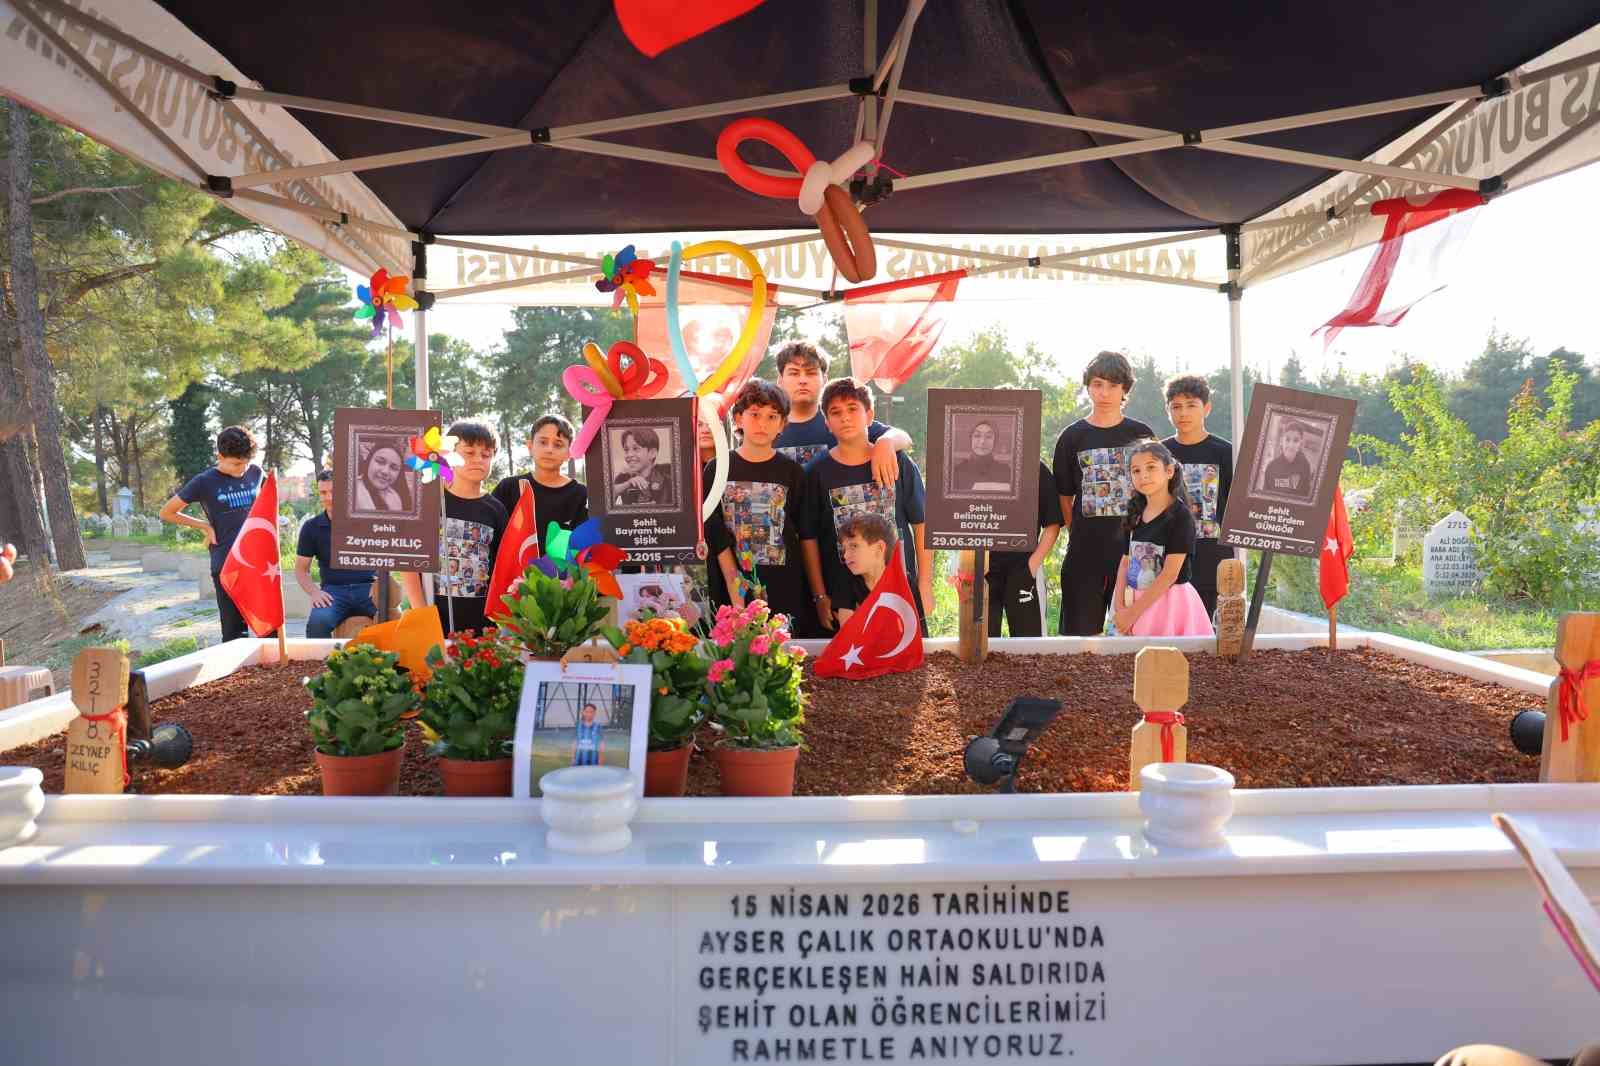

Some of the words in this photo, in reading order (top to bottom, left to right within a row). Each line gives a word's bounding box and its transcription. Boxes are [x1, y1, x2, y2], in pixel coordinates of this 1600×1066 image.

[633, 518, 657, 527] Şehit
[953, 512, 988, 521] Belinay
[990, 512, 1007, 520] Nur
[1248, 510, 1276, 522] Kerem
[1277, 515, 1305, 527] Erdem
[372, 524, 396, 533] Şehit
[615, 527, 652, 536] Bayram
[654, 526, 675, 534] Nabi
[960, 521, 1000, 530] BOYRAZ
[1255, 521, 1294, 534] GÜNGÖR
[1447, 521, 1468, 529] 2715
[346, 536, 389, 549] Zeynep
[391, 538, 422, 549] KILIÇ
[932, 536, 994, 547] 29.06.2015
[1227, 534, 1282, 550] 28.07.2015
[338, 556, 395, 567] 18.05.2015
[70, 743, 112, 759] ZEYNEP
[730, 893, 758, 917] 15
[770, 886, 849, 918] NİSAN
[862, 893, 920, 917] 2026
[932, 884, 1070, 916] TARİHİNDE
[700, 930, 785, 954] AYSER
[798, 929, 875, 958] ÇALIK
[887, 926, 1105, 952] ORTAOKULU'NDA
[699, 965, 888, 995] GERÇEKLEŞEN
[900, 957, 959, 987] HAİN
[972, 961, 1106, 986] SALDIRIDA
[699, 999, 776, 1034] ŞEHİT
[789, 1004, 857, 1027] OLAN
[871, 992, 1107, 1026] ÖĞRENCİLERİMİZİ
[732, 1036, 895, 1061] RAHMETLE
[909, 1033, 1075, 1059] ANIYORUZ.
